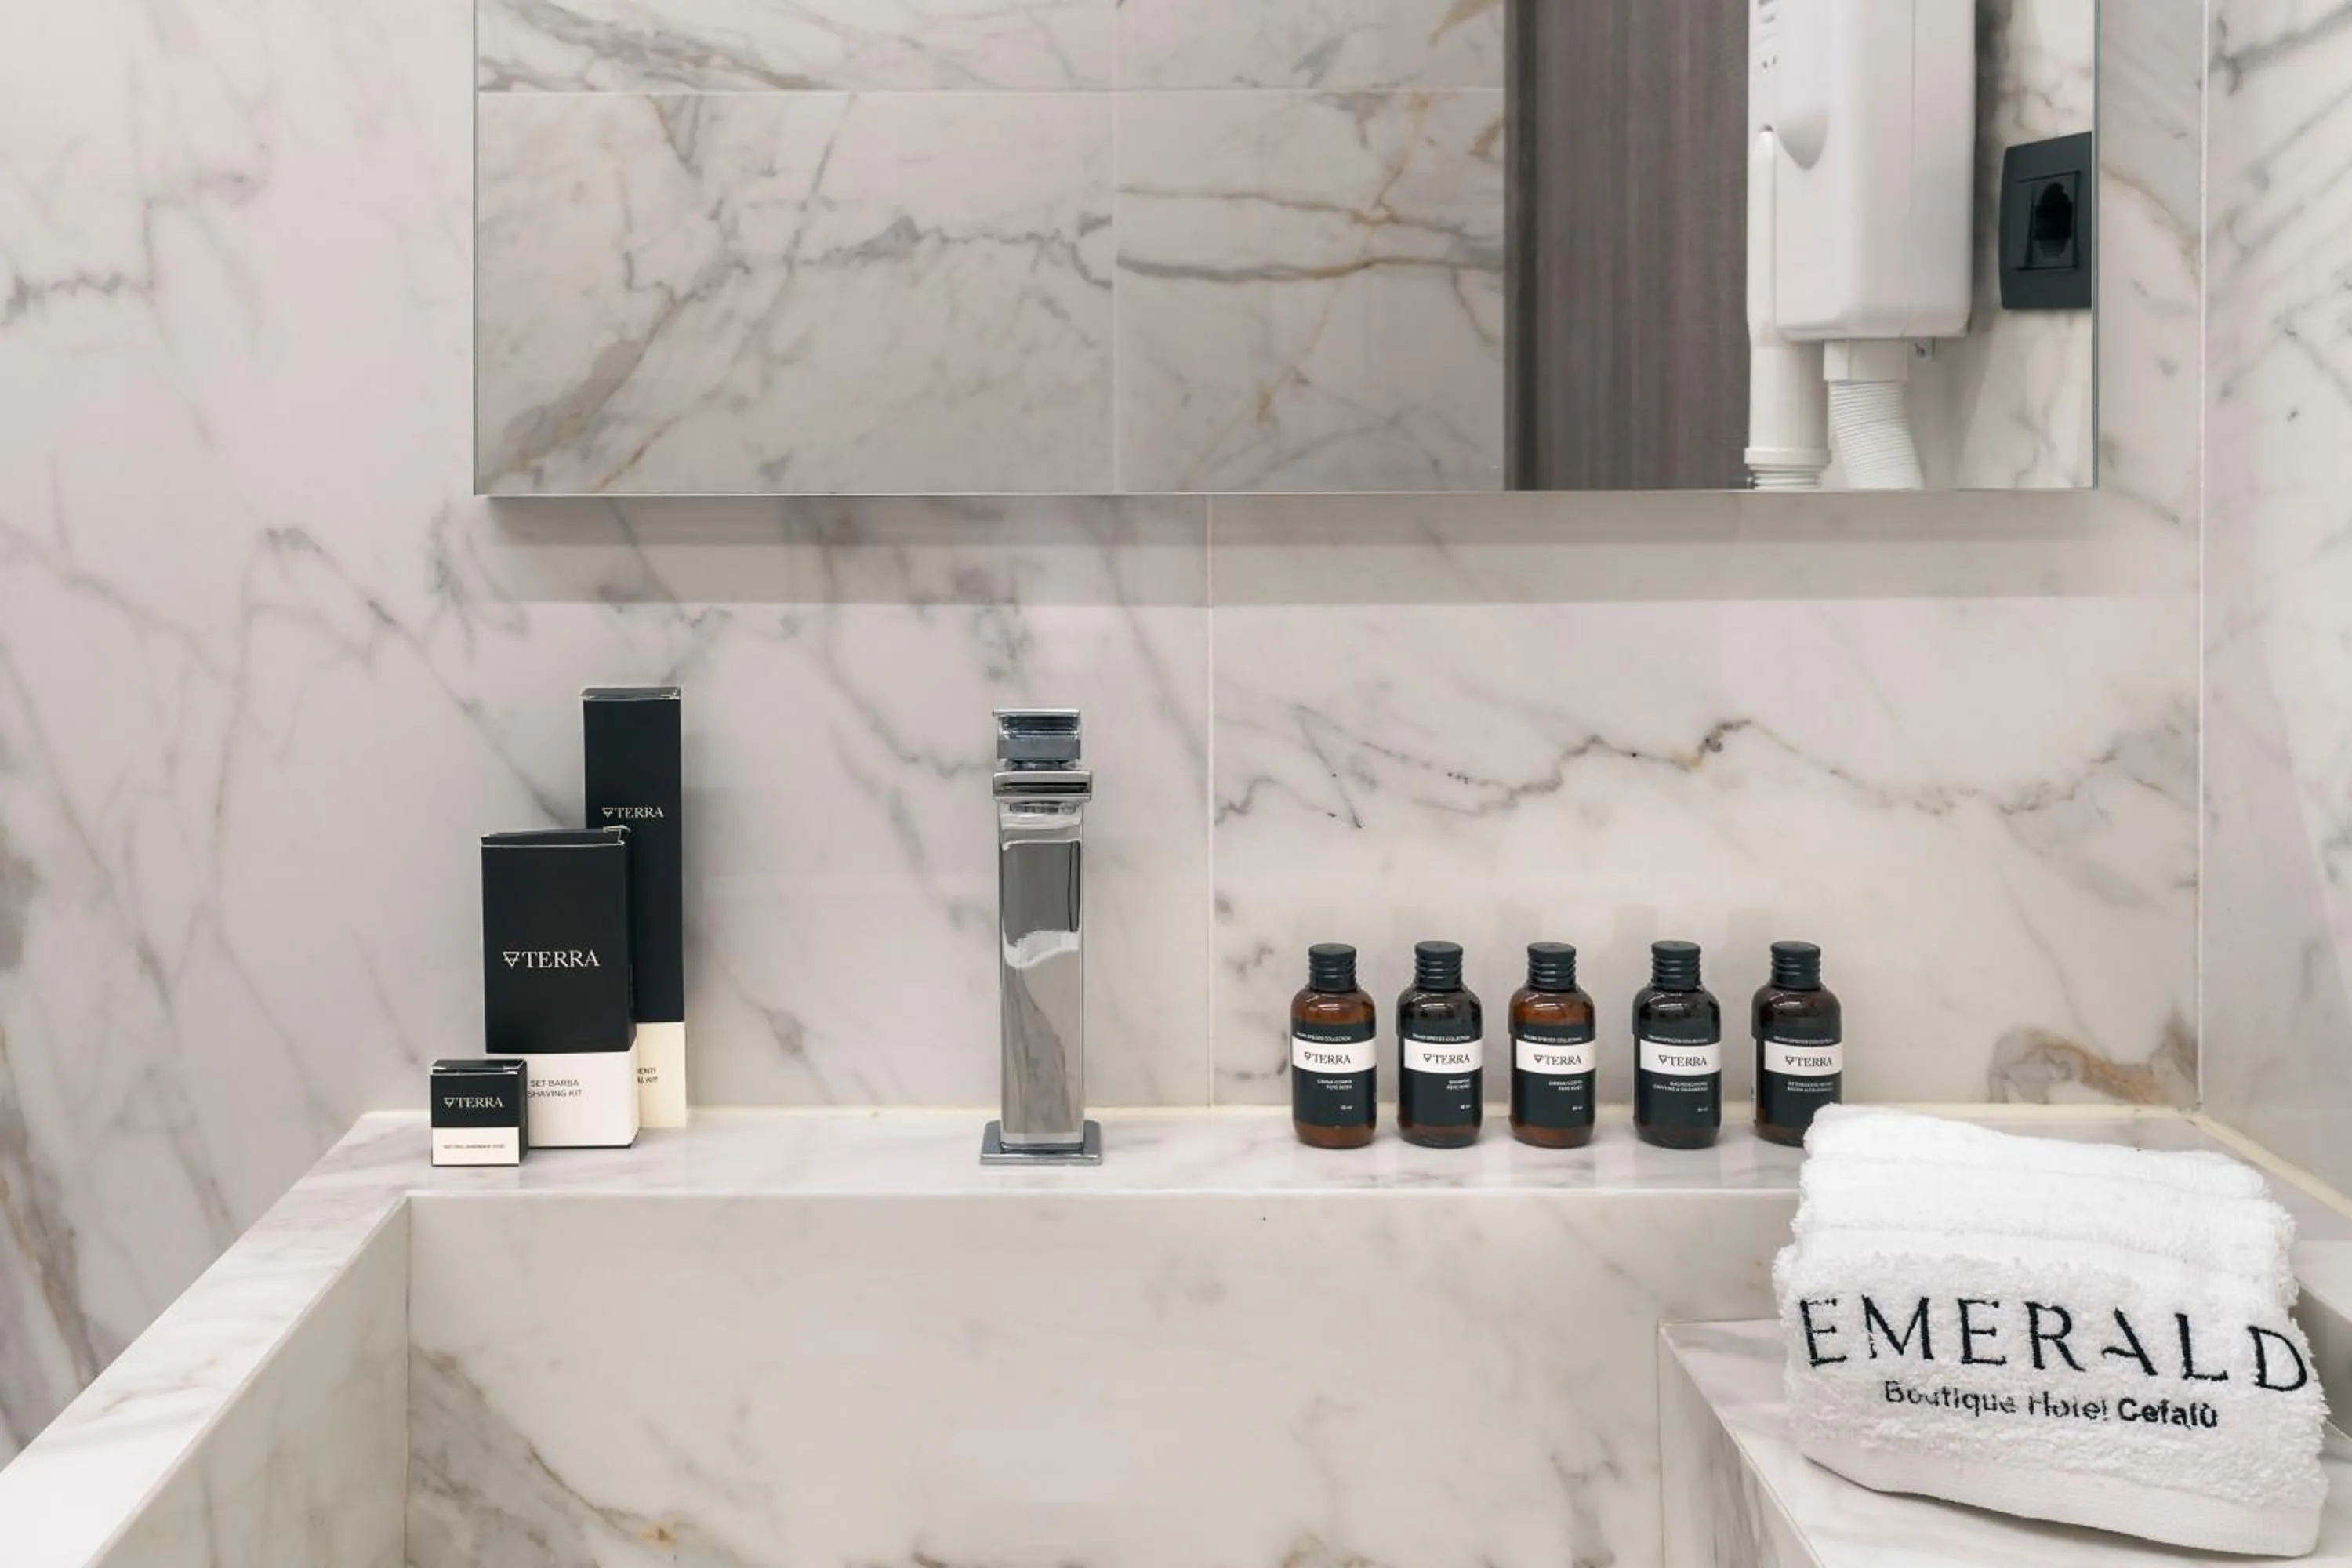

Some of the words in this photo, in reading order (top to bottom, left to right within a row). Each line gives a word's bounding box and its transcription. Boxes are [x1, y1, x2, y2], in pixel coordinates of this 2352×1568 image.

[614, 806, 665, 818] TERRA
[521, 949, 601, 969] TERRA
[1312, 1053, 1352, 1065] TERRA
[1432, 1053, 1471, 1065] TERRA
[1544, 1054, 1582, 1065] TERRA
[1668, 1056, 1708, 1067] TERRA
[1795, 1056, 1833, 1067] TERRA
[527, 1089, 568, 1098] SHAVING
[456, 1096, 506, 1109] TERRA
[1799, 1293, 2308, 1392] EMERALD
[1884, 1380, 2017, 1418] Boutique
[2027, 1390, 2109, 1421] Hotel
[2118, 1397, 2220, 1430] Cefalù
